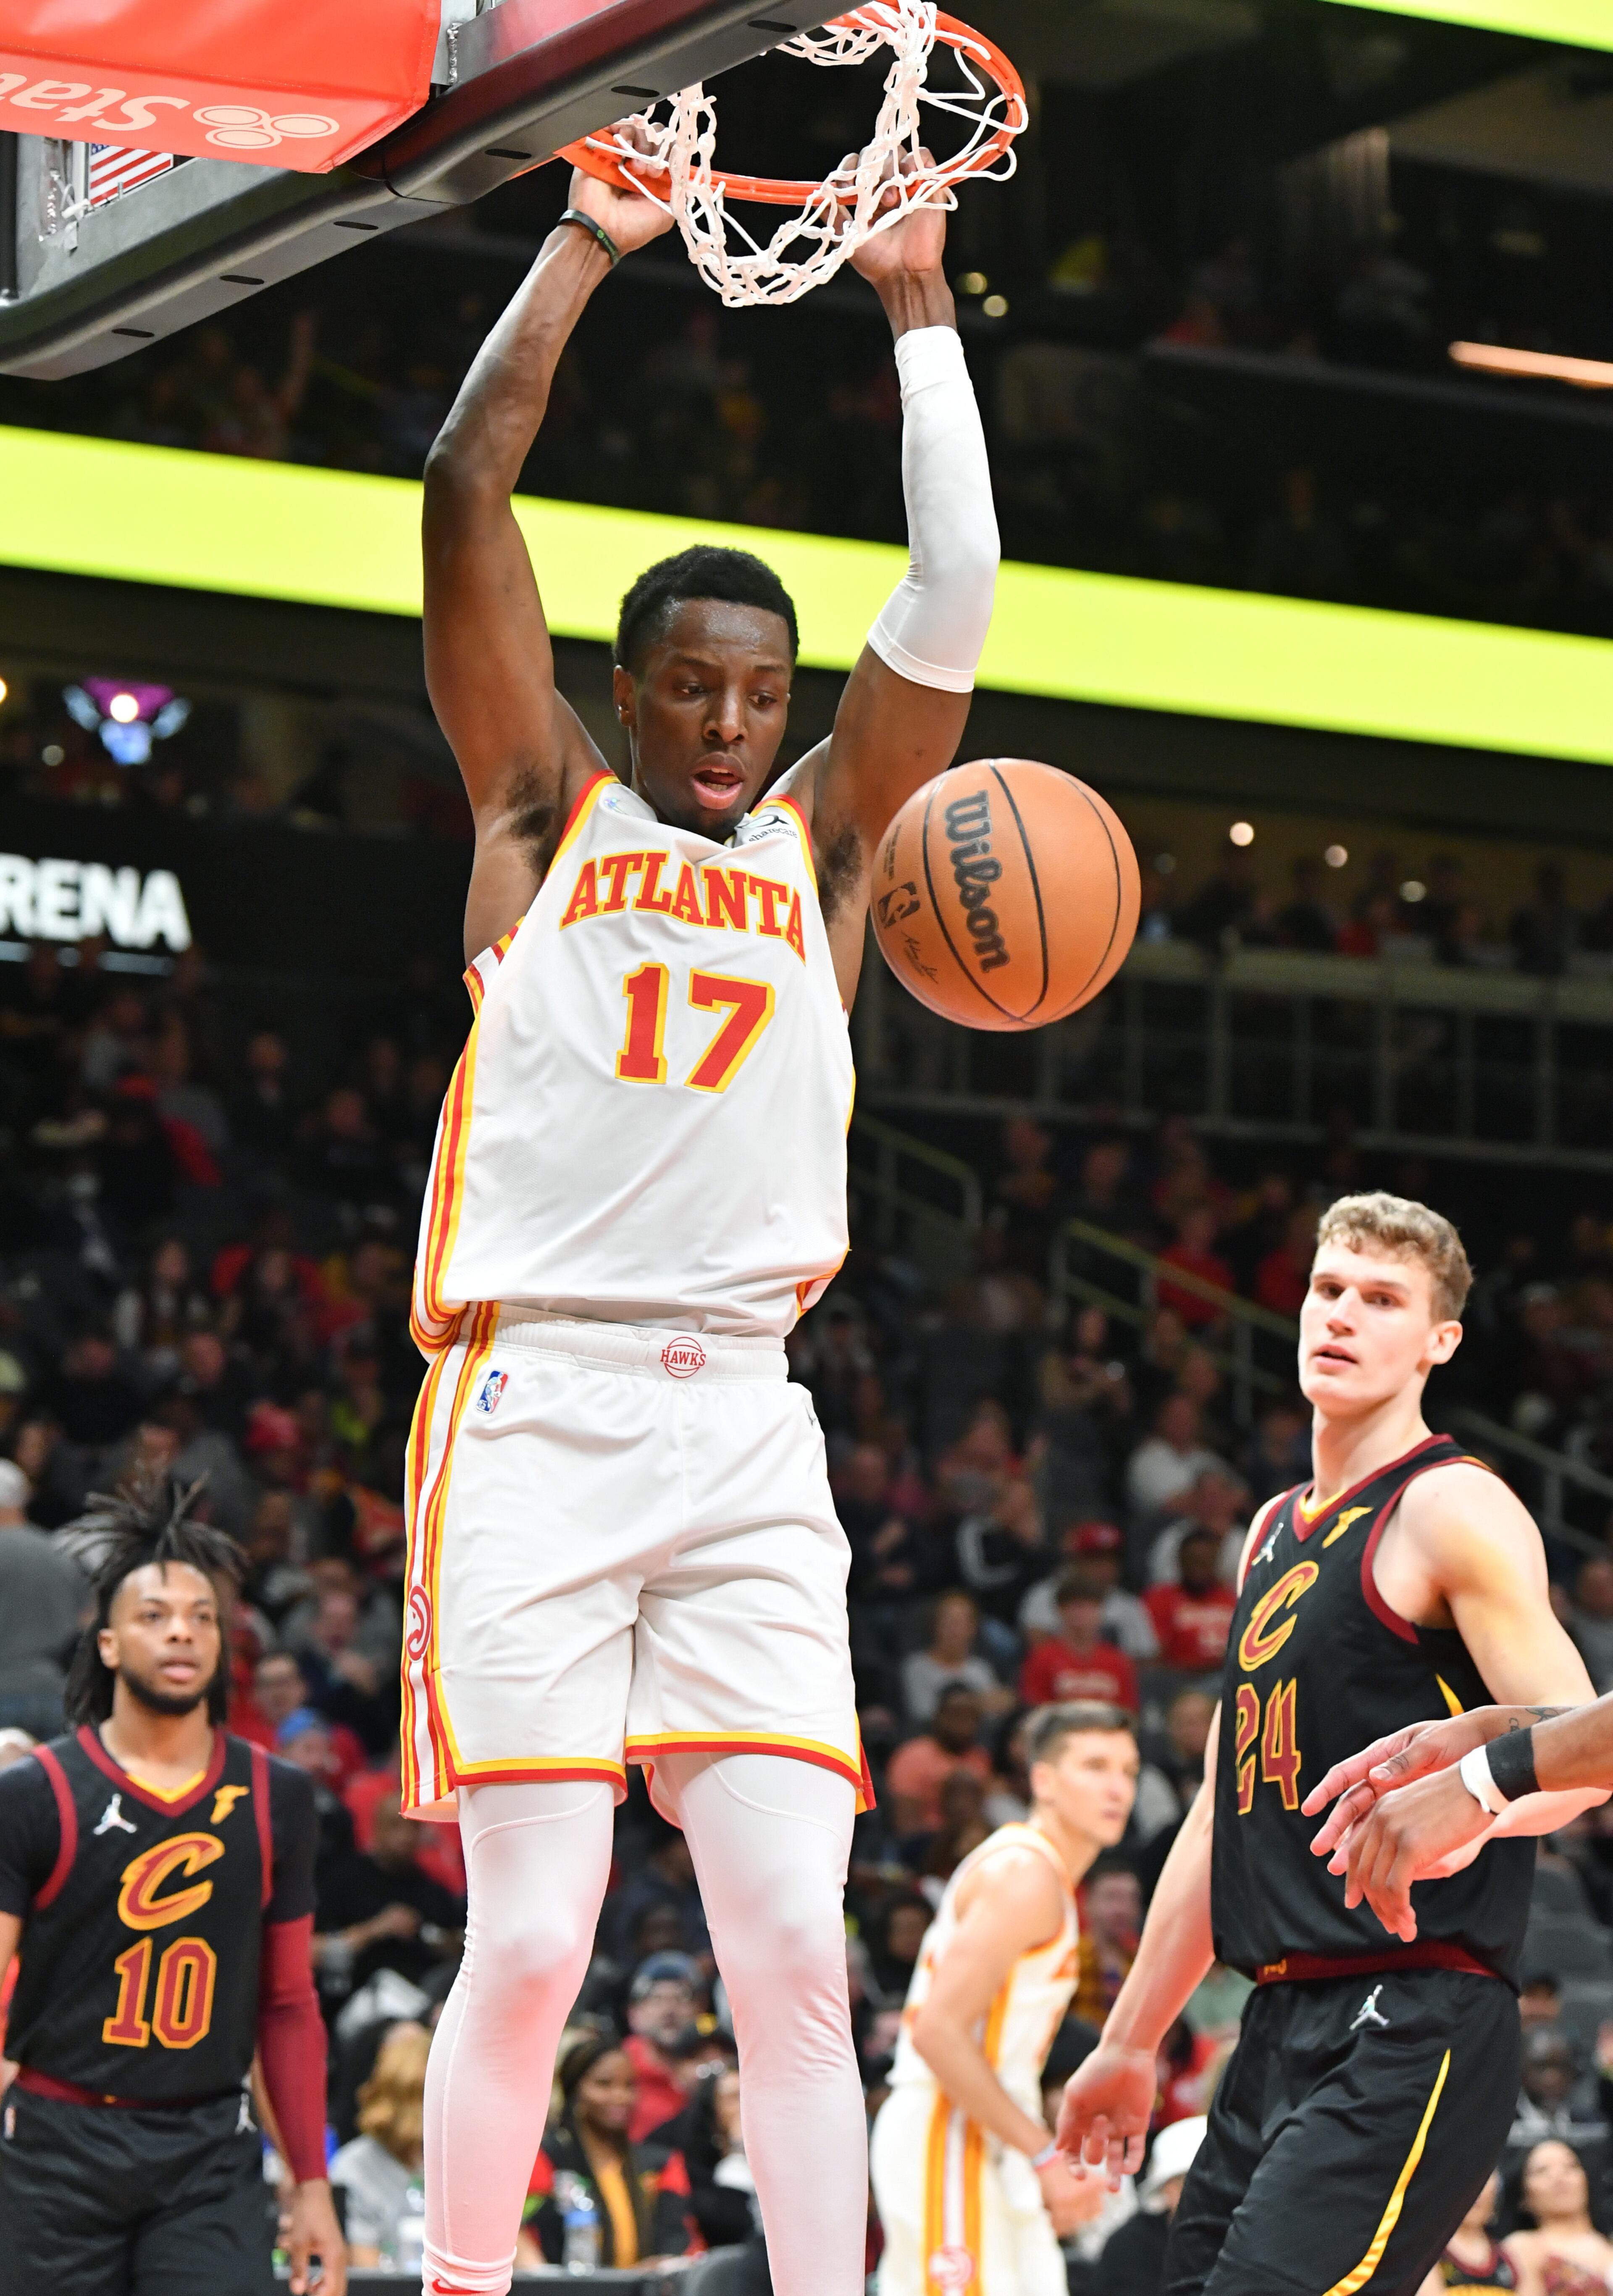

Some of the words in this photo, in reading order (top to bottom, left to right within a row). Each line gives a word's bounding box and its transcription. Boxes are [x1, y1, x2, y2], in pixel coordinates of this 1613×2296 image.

[749, 828, 798, 842] sharecare
[943, 789, 1010, 973] Wilson
[560, 850, 806, 966] ATLANTA
[615, 961, 775, 1093] 17
[660, 1349, 707, 1366] HAWKS
[1236, 1677, 1301, 1815] 24
[102, 1936, 217, 2050] 10
